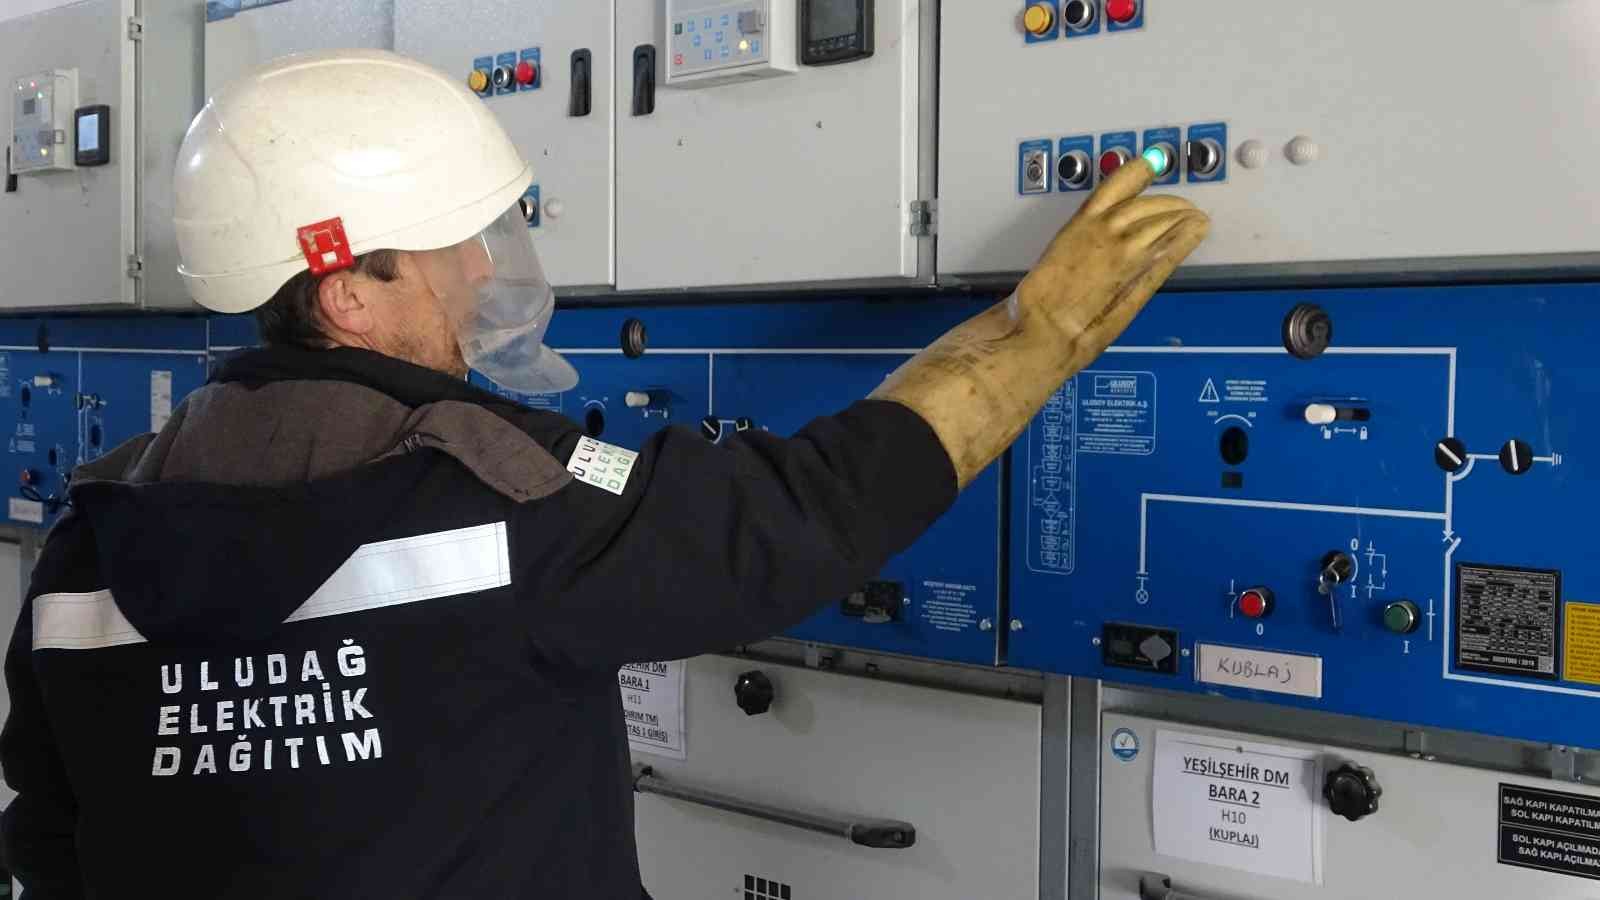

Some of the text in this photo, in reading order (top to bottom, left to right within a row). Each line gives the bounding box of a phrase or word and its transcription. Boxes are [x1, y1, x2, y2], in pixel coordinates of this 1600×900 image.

[161, 638, 367, 694] ULUDAĞ
[620, 674, 643, 687] BARA
[158, 682, 373, 735] ELEKTRİK
[151, 728, 383, 776] DAĞITIM
[1184, 756, 1289, 785] YEŞİLŞEHİR DM
[1209, 784, 1260, 805] BARA 2
[1526, 800, 1547, 810] KAPI
[1221, 808, 1247, 825] H10
[1511, 808, 1530, 819] SOL
[1531, 812, 1554, 823] KAPI
[1209, 826, 1259, 849] (KUPLAJ)
[1512, 834, 1532, 844] SOL
[1533, 837, 1555, 848] KAPI
[1540, 850, 1562, 861] KAPI
